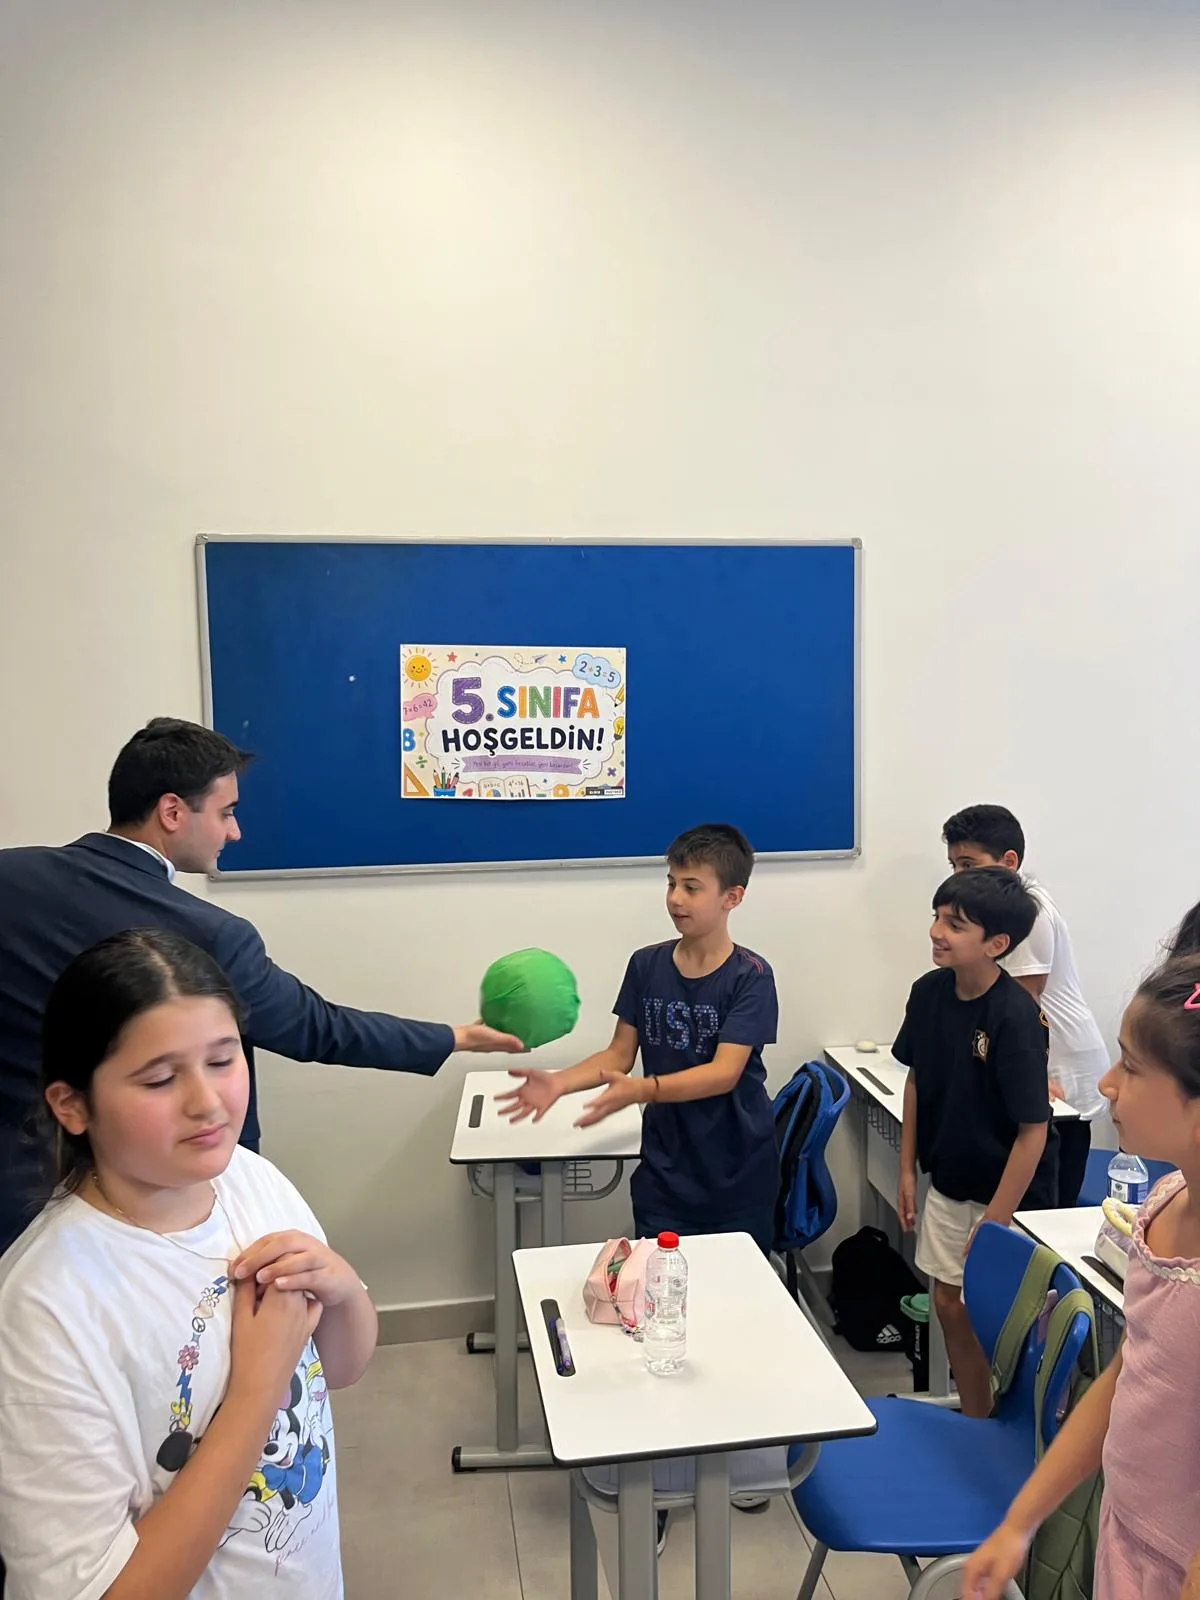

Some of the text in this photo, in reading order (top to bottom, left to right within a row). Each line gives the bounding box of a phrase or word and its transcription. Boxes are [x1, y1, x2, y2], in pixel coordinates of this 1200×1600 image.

[451, 676, 600, 725] 5. SINIFA
[441, 725, 605, 757] HOŞGELDİN!
